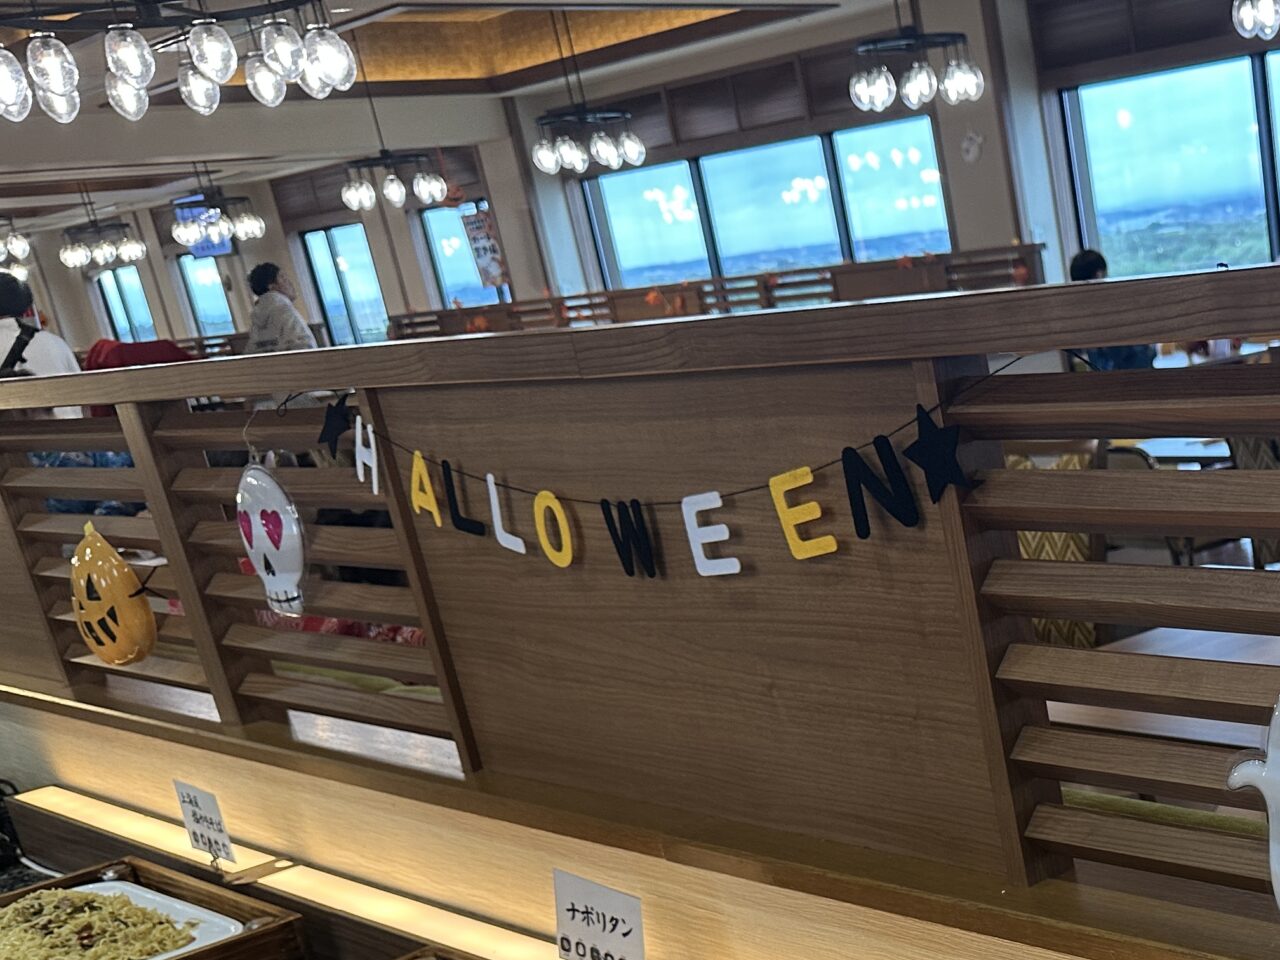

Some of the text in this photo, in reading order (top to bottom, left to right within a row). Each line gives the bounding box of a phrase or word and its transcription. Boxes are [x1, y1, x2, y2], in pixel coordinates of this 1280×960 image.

[355, 414, 918, 577] HALLOWEEN
[565, 901, 633, 938] ナポリタン
